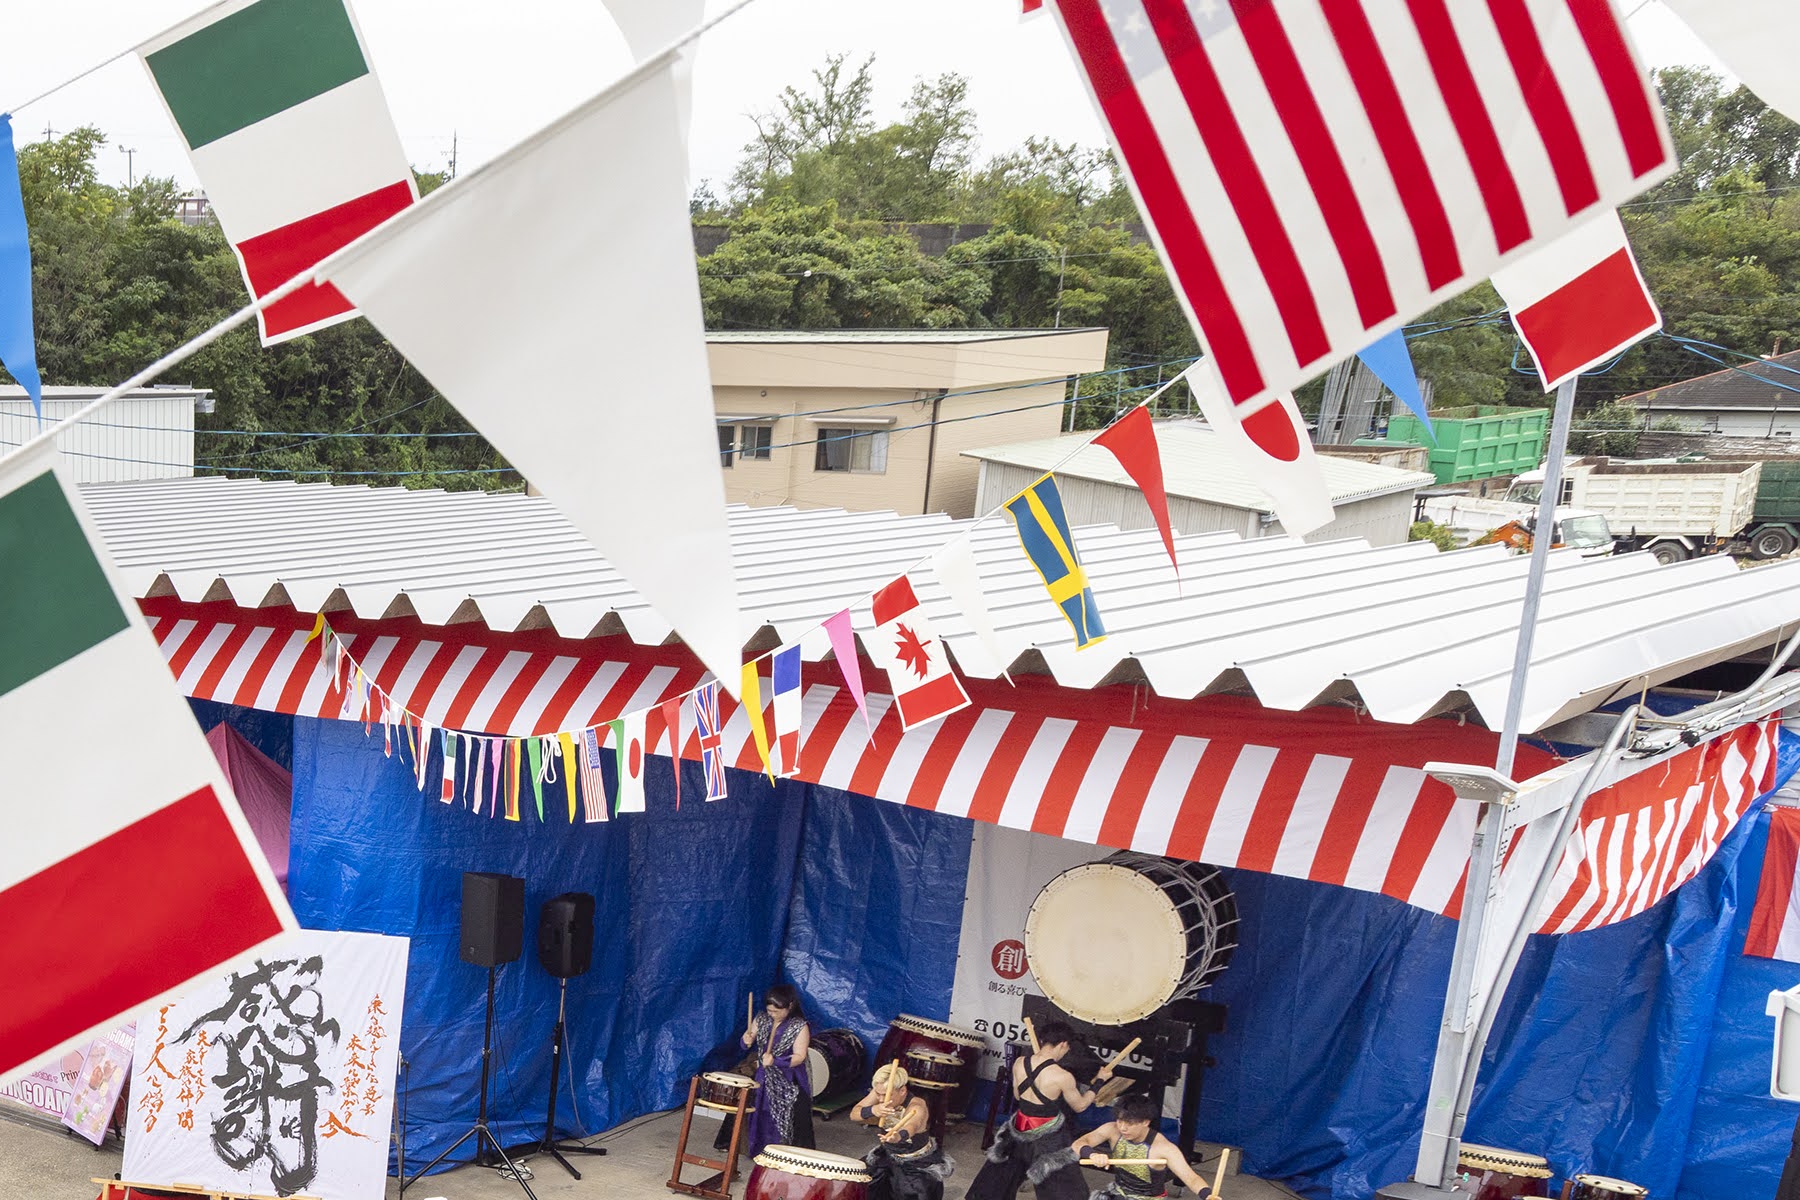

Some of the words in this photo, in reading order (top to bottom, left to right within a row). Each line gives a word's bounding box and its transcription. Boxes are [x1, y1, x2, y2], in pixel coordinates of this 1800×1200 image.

[995, 944, 1026, 974] 創
[988, 980, 1028, 996] 創る喜び
[170, 954, 341, 1198] 感謝
